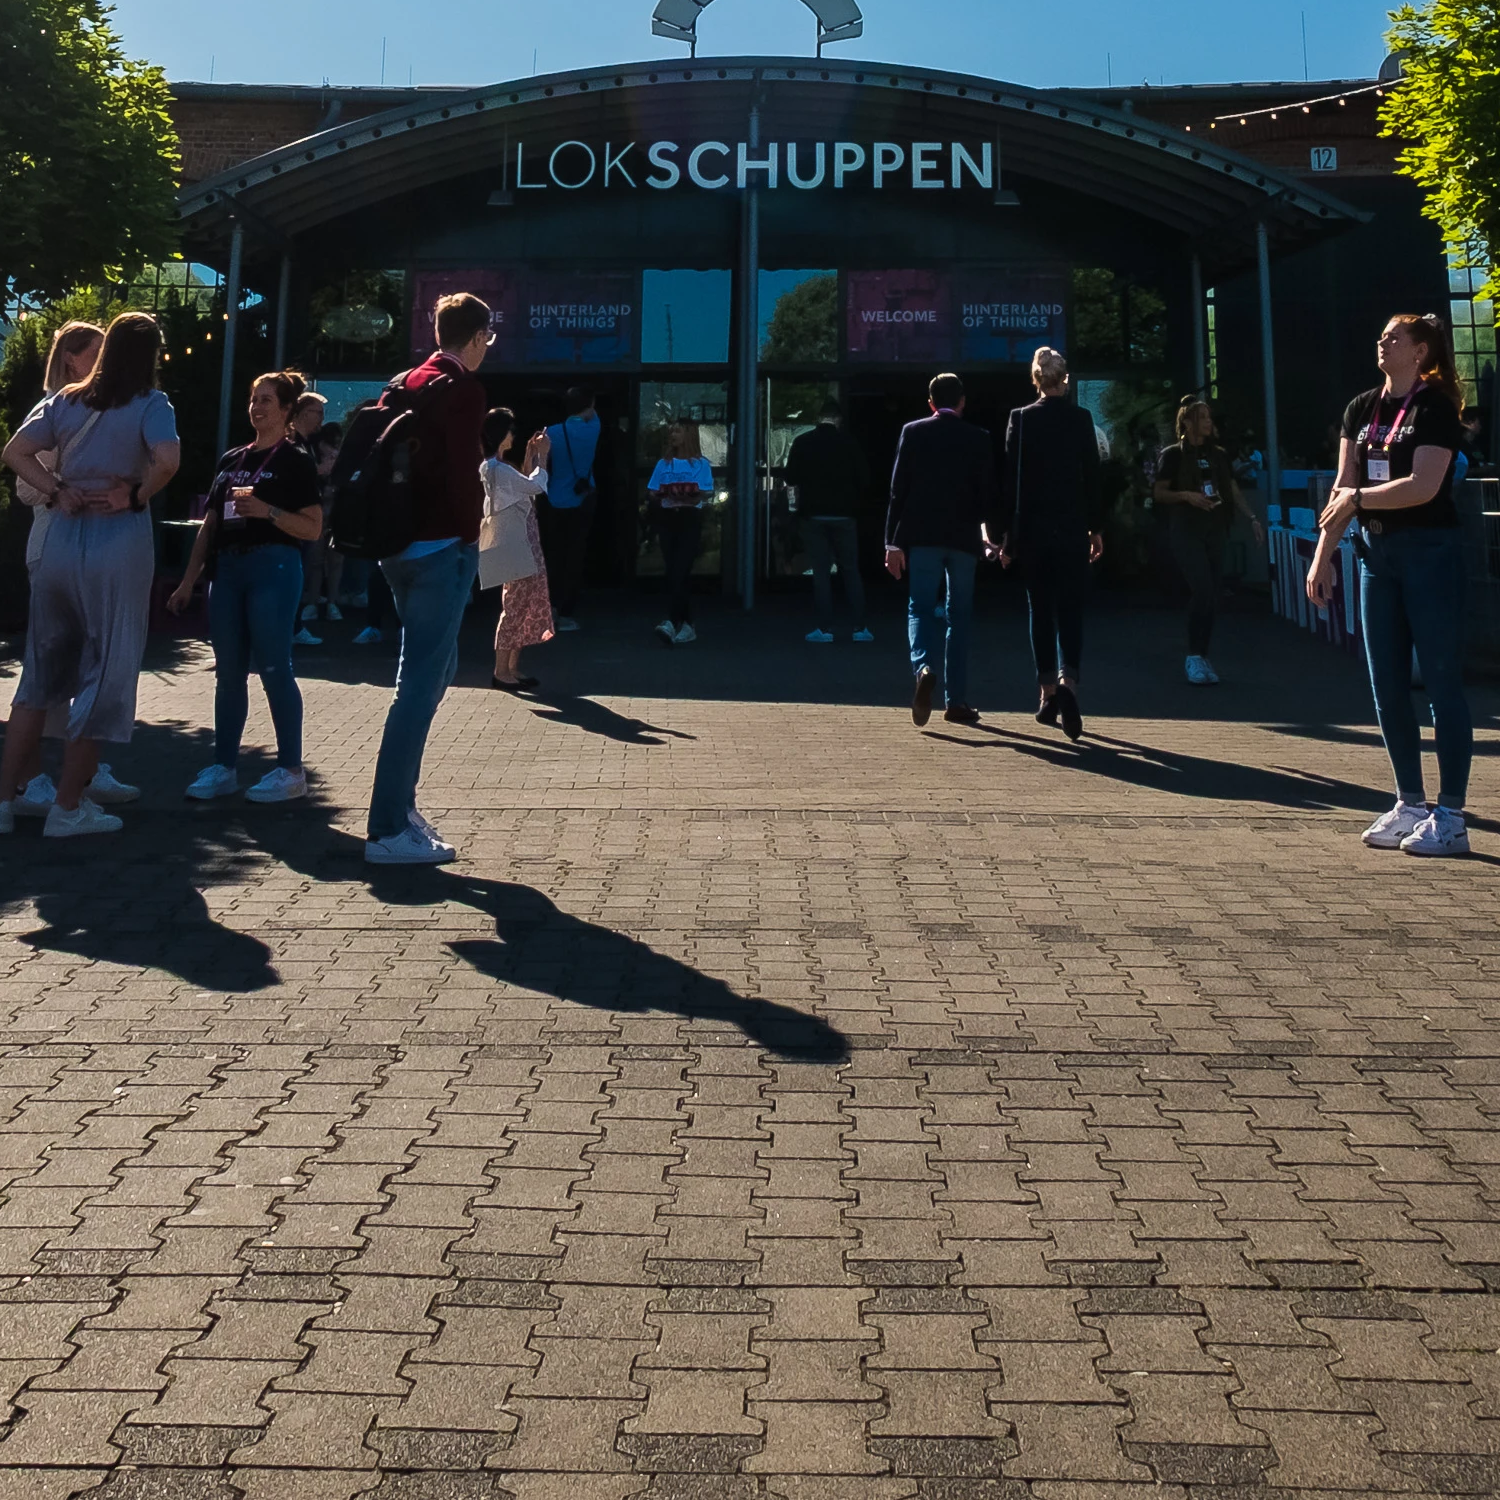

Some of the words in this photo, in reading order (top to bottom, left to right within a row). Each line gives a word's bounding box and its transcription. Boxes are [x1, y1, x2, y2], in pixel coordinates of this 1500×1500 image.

[1314, 148, 1333, 169] 12
[517, 141, 992, 190] LOKSCHUPPEN
[530, 304, 632, 316] HINTERLAND
[861, 310, 936, 323] WELCOME
[963, 304, 1063, 316] HINTERLAND
[530, 316, 551, 328] OF
[557, 316, 616, 329] THINGS
[963, 316, 983, 328] OF
[989, 316, 1048, 328] THINGS
